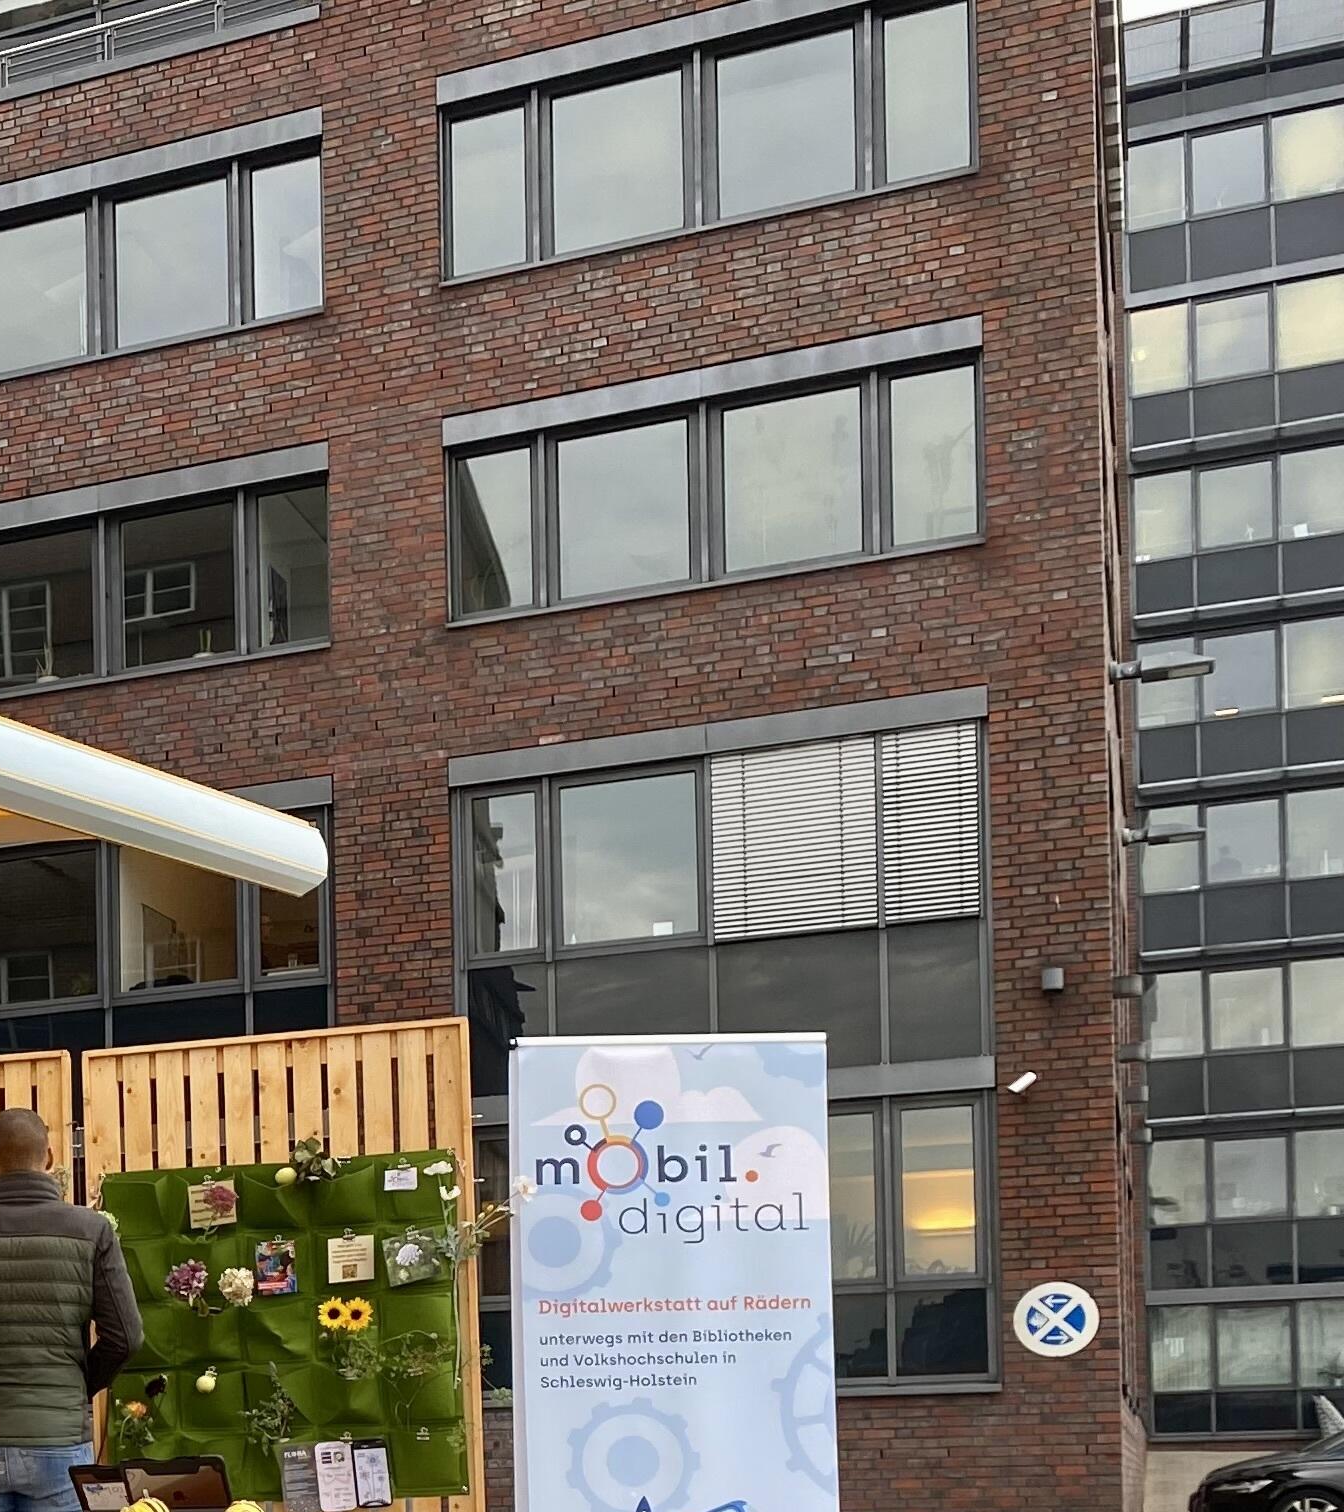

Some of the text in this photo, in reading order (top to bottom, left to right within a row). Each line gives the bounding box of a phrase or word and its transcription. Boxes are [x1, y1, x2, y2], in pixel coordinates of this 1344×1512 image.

[618, 1192, 810, 1244] digital
[538, 1294, 812, 1319] Digitalwerkstatt auf Rädern
[539, 1328, 792, 1348] unterwegs mit den Bibliotheken
[540, 1351, 737, 1368] und Volkshochschulen in
[540, 1373, 698, 1390] Schleswig-Holstein
